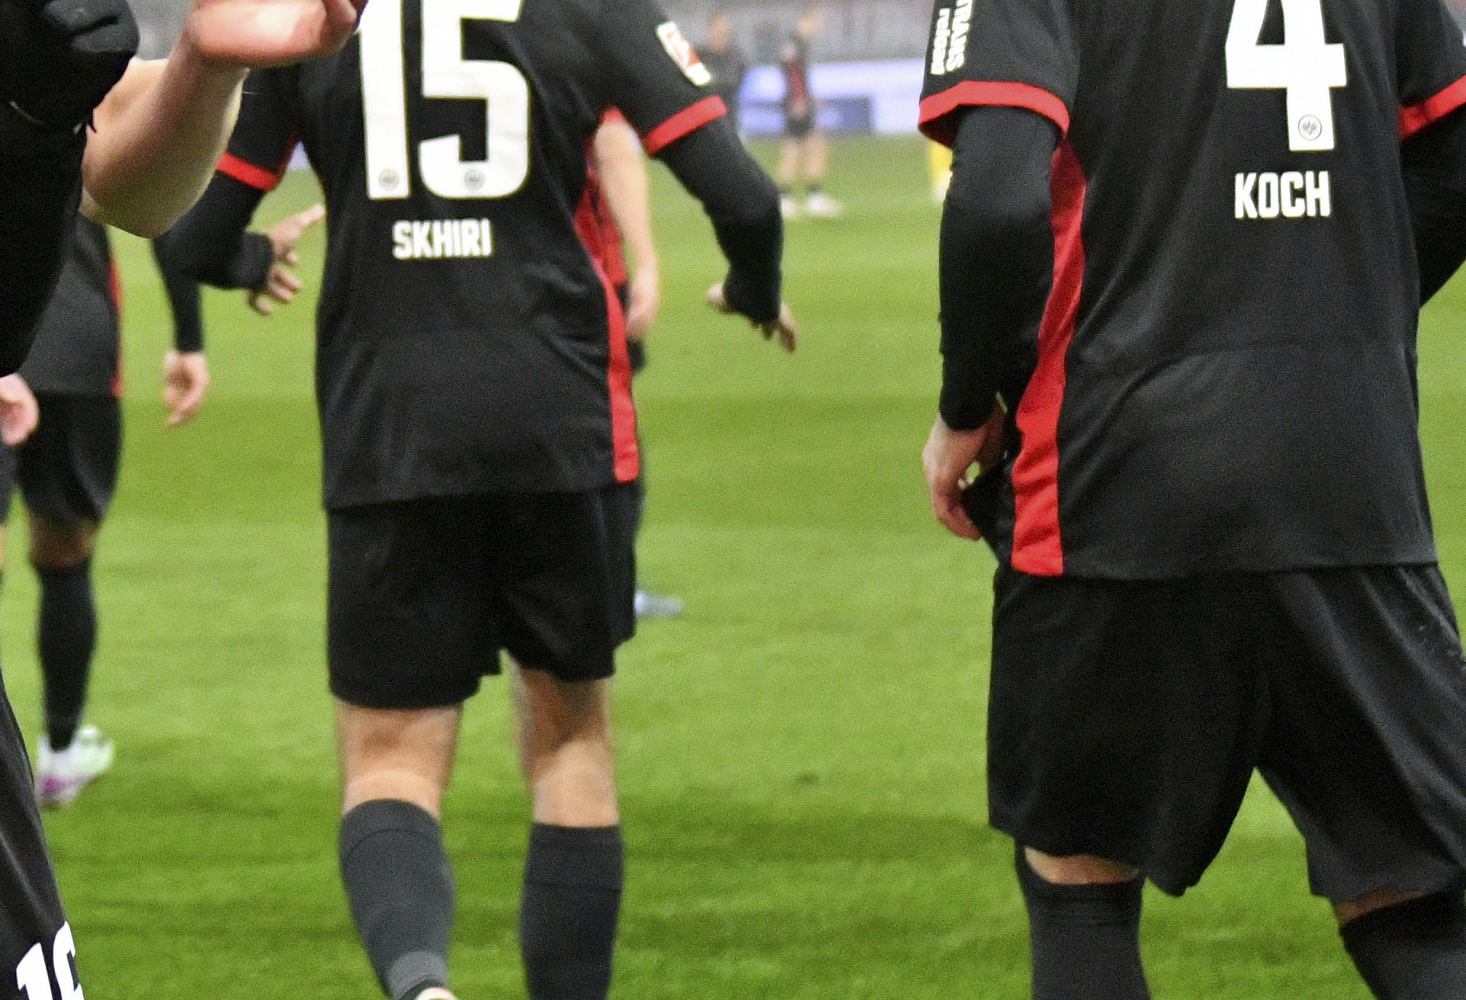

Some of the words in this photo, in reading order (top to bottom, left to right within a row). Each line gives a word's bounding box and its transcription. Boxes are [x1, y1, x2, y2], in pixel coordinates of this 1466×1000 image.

[930, 7, 951, 75] reload
[1234, 170, 1332, 219] KOCH
[392, 218, 493, 259] SKHIRI
